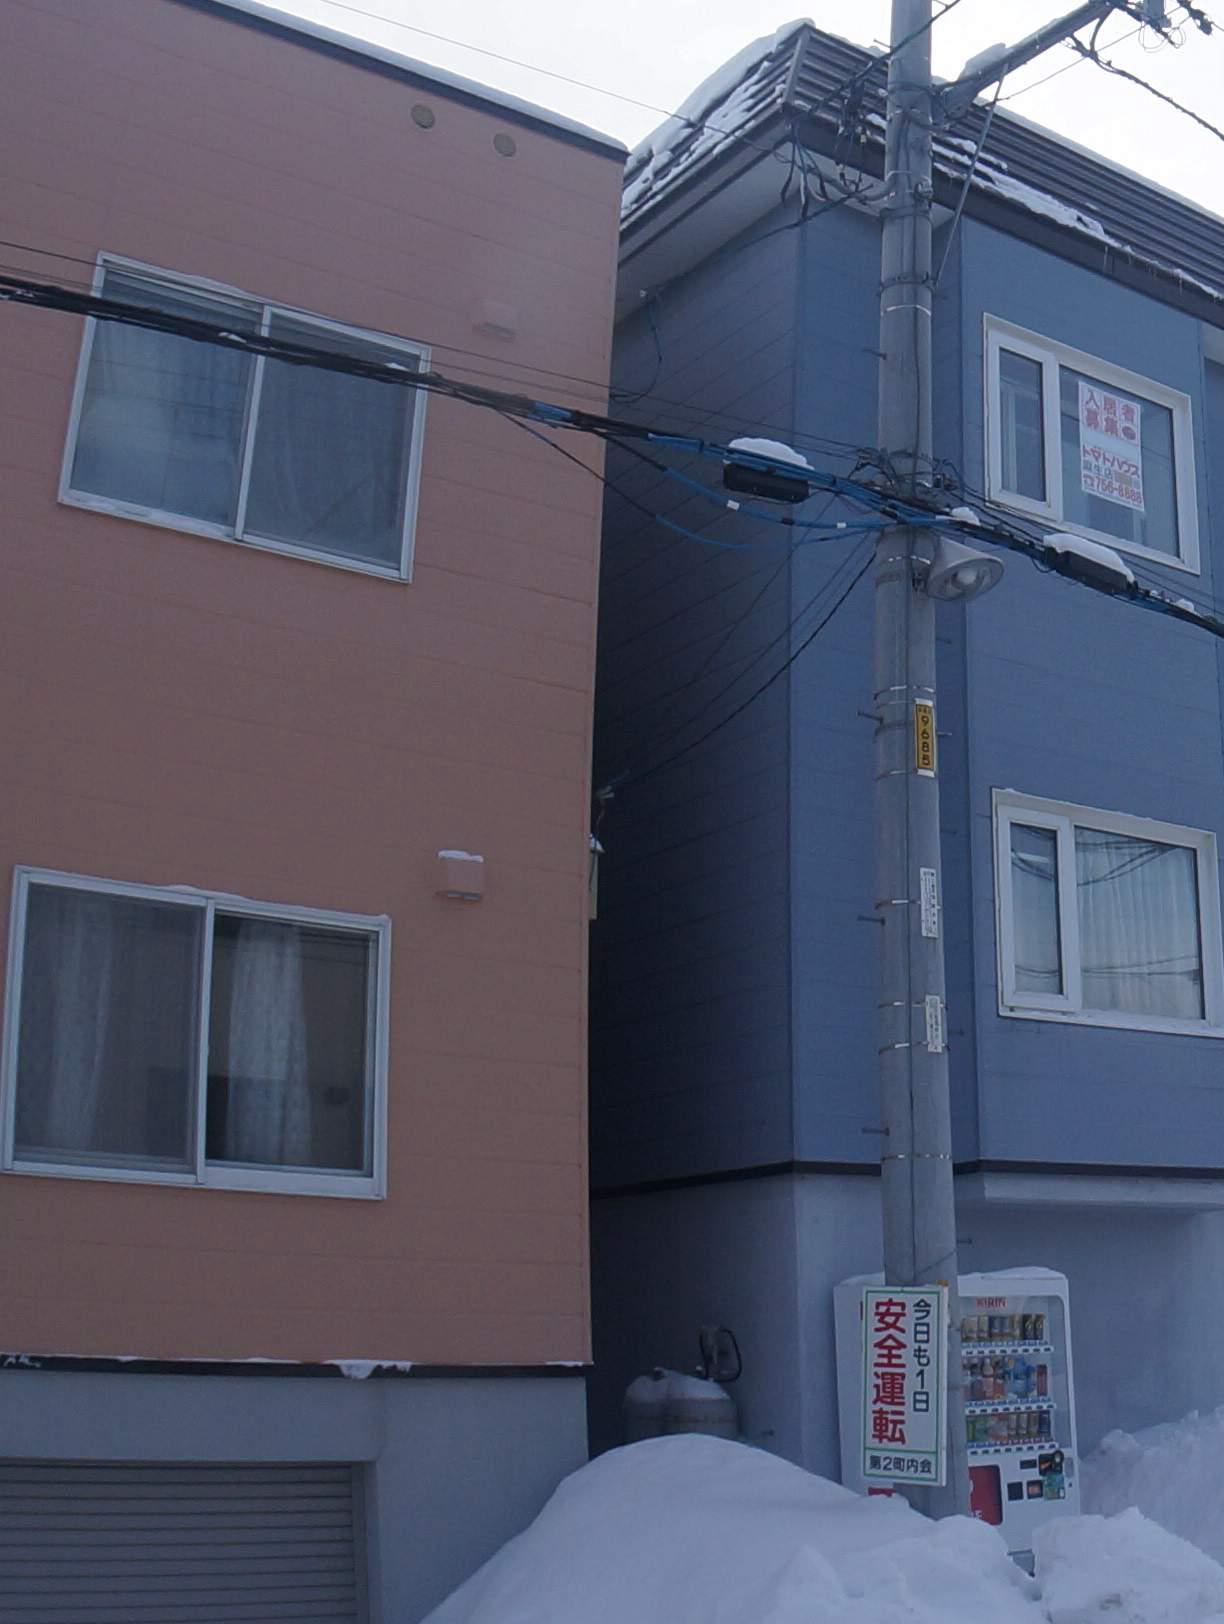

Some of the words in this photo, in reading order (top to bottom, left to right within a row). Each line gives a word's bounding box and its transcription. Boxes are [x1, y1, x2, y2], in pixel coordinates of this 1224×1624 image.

[976, 1297, 1008, 1308] KIRIN
[871, 1298, 907, 1445] 安全運転
[912, 1298, 932, 1412] 今日も1日
[869, 1455, 932, 1474] 第2町内会
